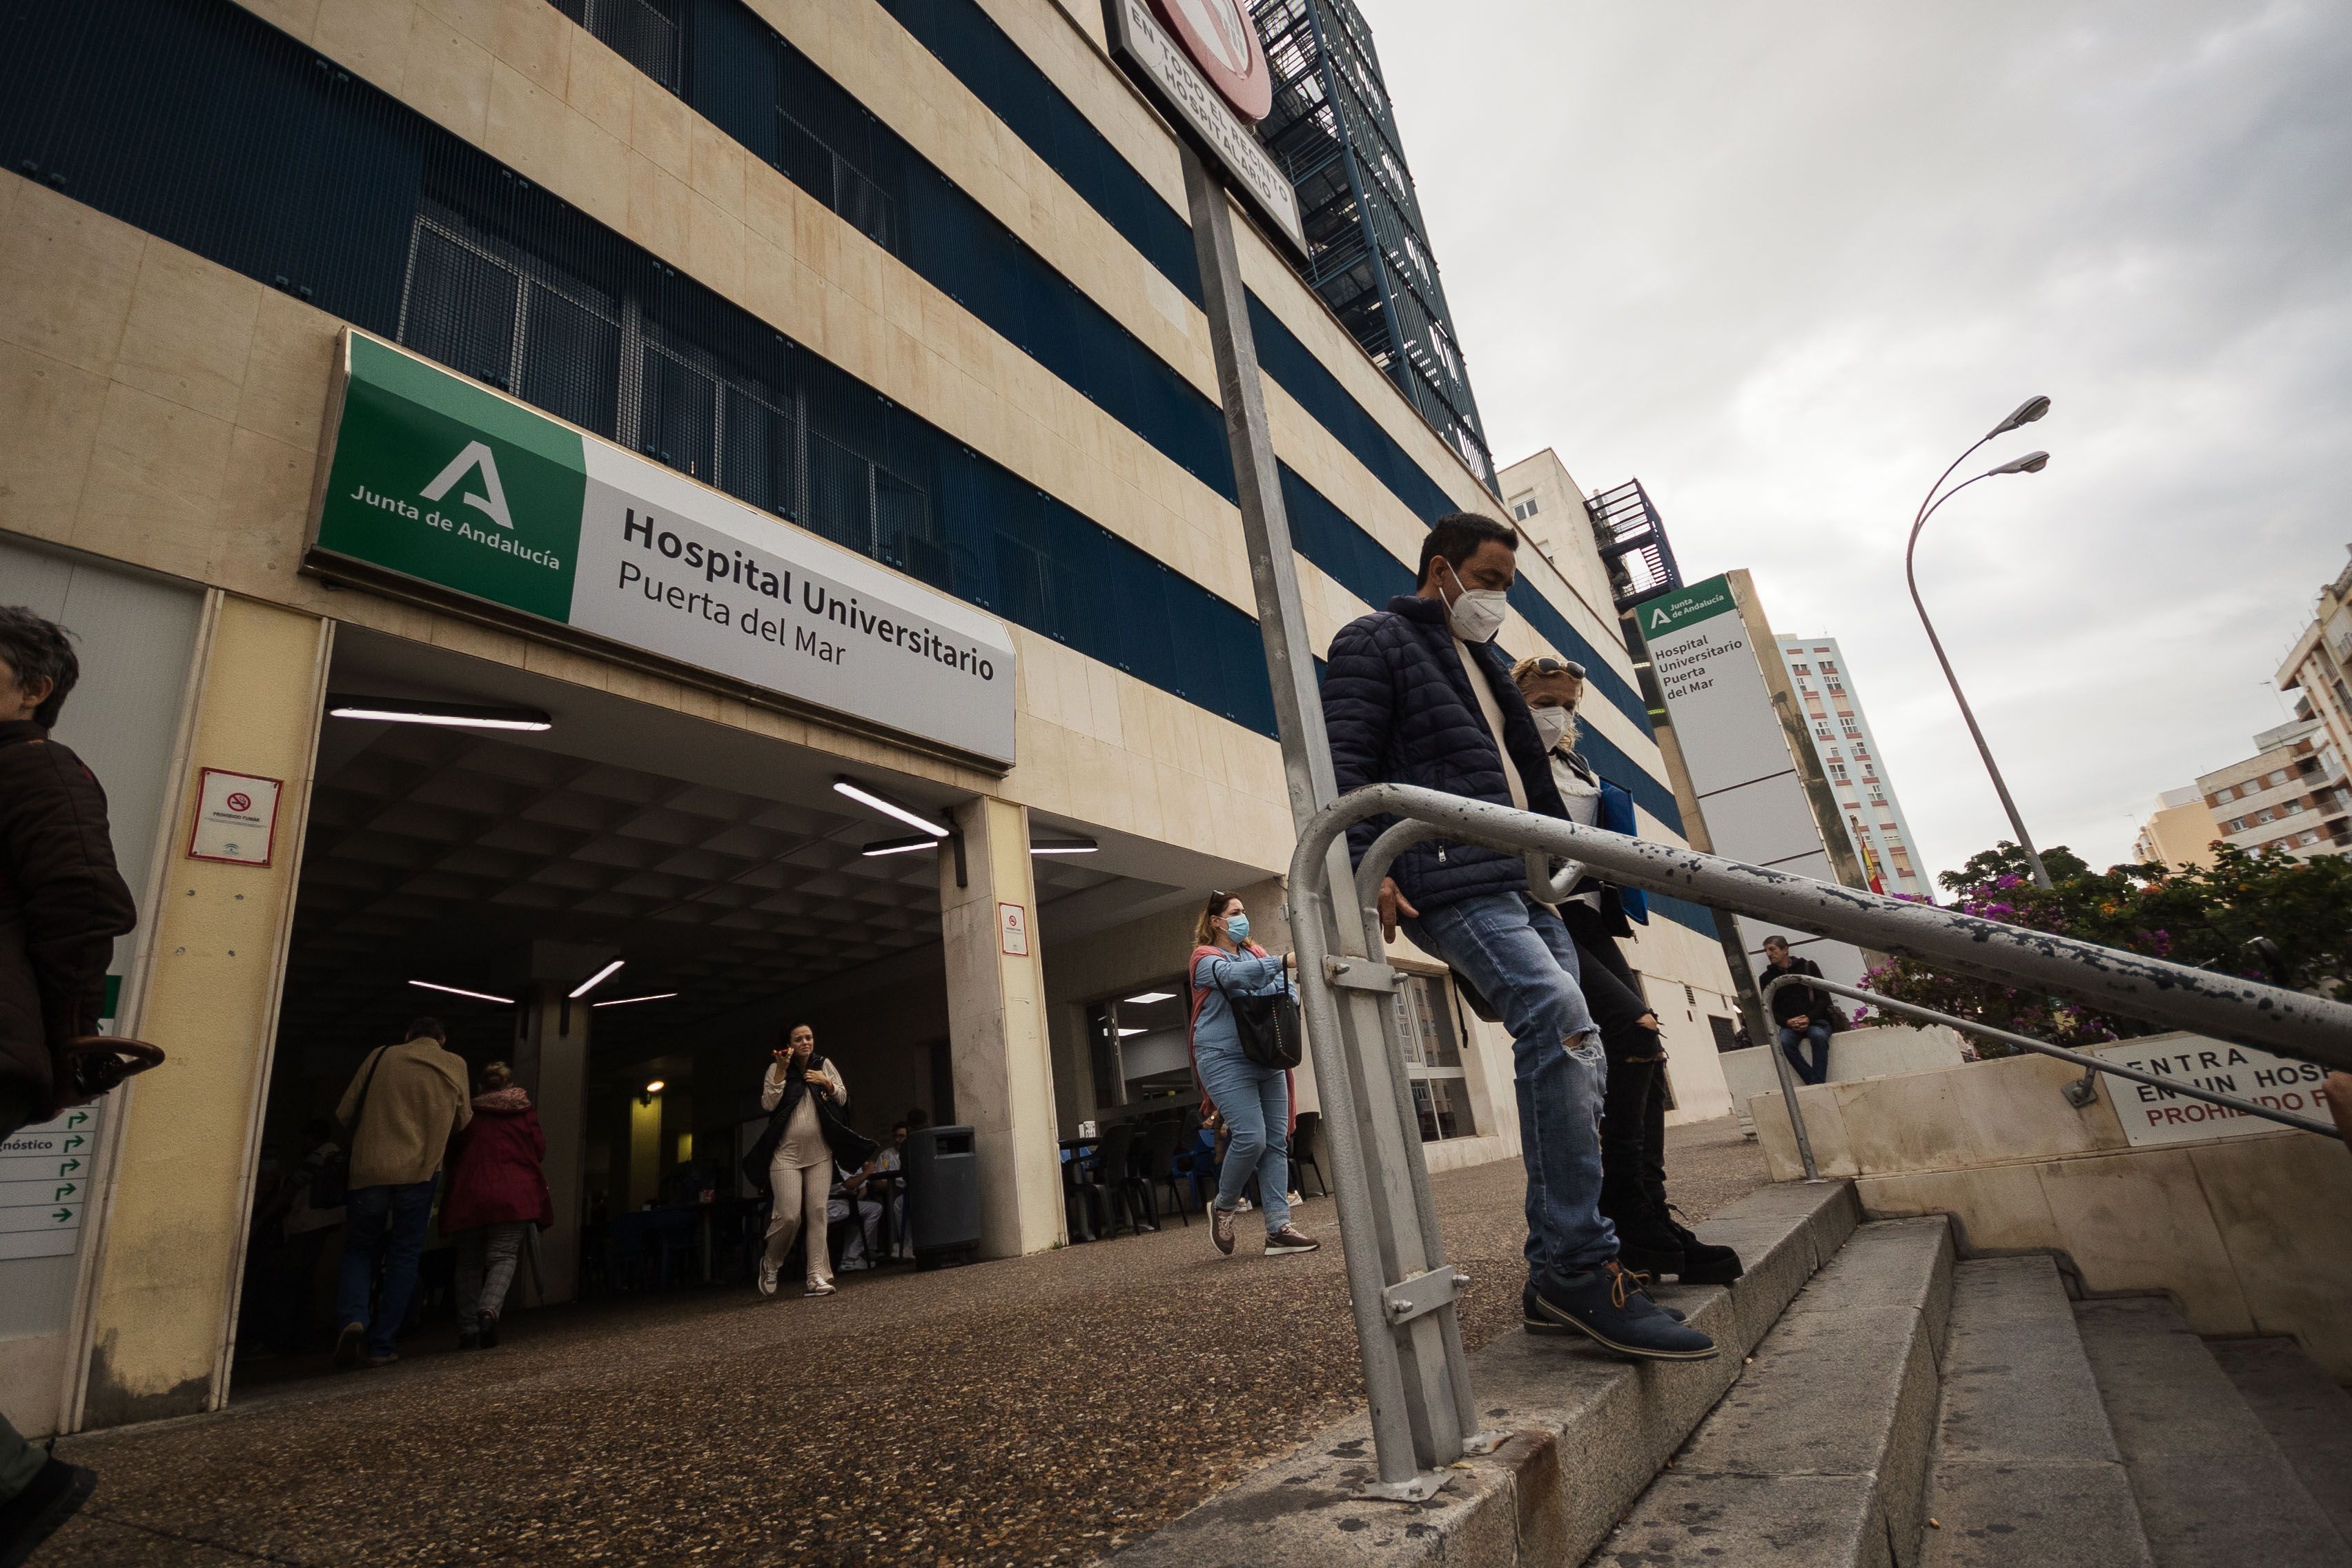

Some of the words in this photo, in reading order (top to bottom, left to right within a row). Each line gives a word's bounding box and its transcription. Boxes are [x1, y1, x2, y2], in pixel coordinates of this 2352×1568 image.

[1131, 6, 1155, 43] EN
[1160, 41, 1204, 102] TODO
[1209, 99, 1227, 130] EL
[1231, 126, 1288, 202] RECINTO
[1164, 65, 1271, 199] HOSPITALARIO
[351, 485, 420, 520] Junta
[425, 511, 453, 531] de
[458, 522, 560, 569] Andalucía
[623, 507, 792, 605] Hospital
[803, 580, 994, 681] Universitario
[1670, 598, 1694, 611] Junta
[1672, 610, 1683, 618] de
[1683, 594, 1725, 614] Andalucía
[618, 560, 730, 626] Puerta
[741, 607, 785, 647] del
[795, 625, 846, 665] Mar
[1655, 634, 1709, 660] Hospital
[1659, 640, 1743, 674] Universitario
[1663, 667, 1706, 687] Puerta
[1667, 685, 1687, 700] del
[1690, 678, 1714, 693] Mar
[0, 1139, 53, 1153] nóstico
